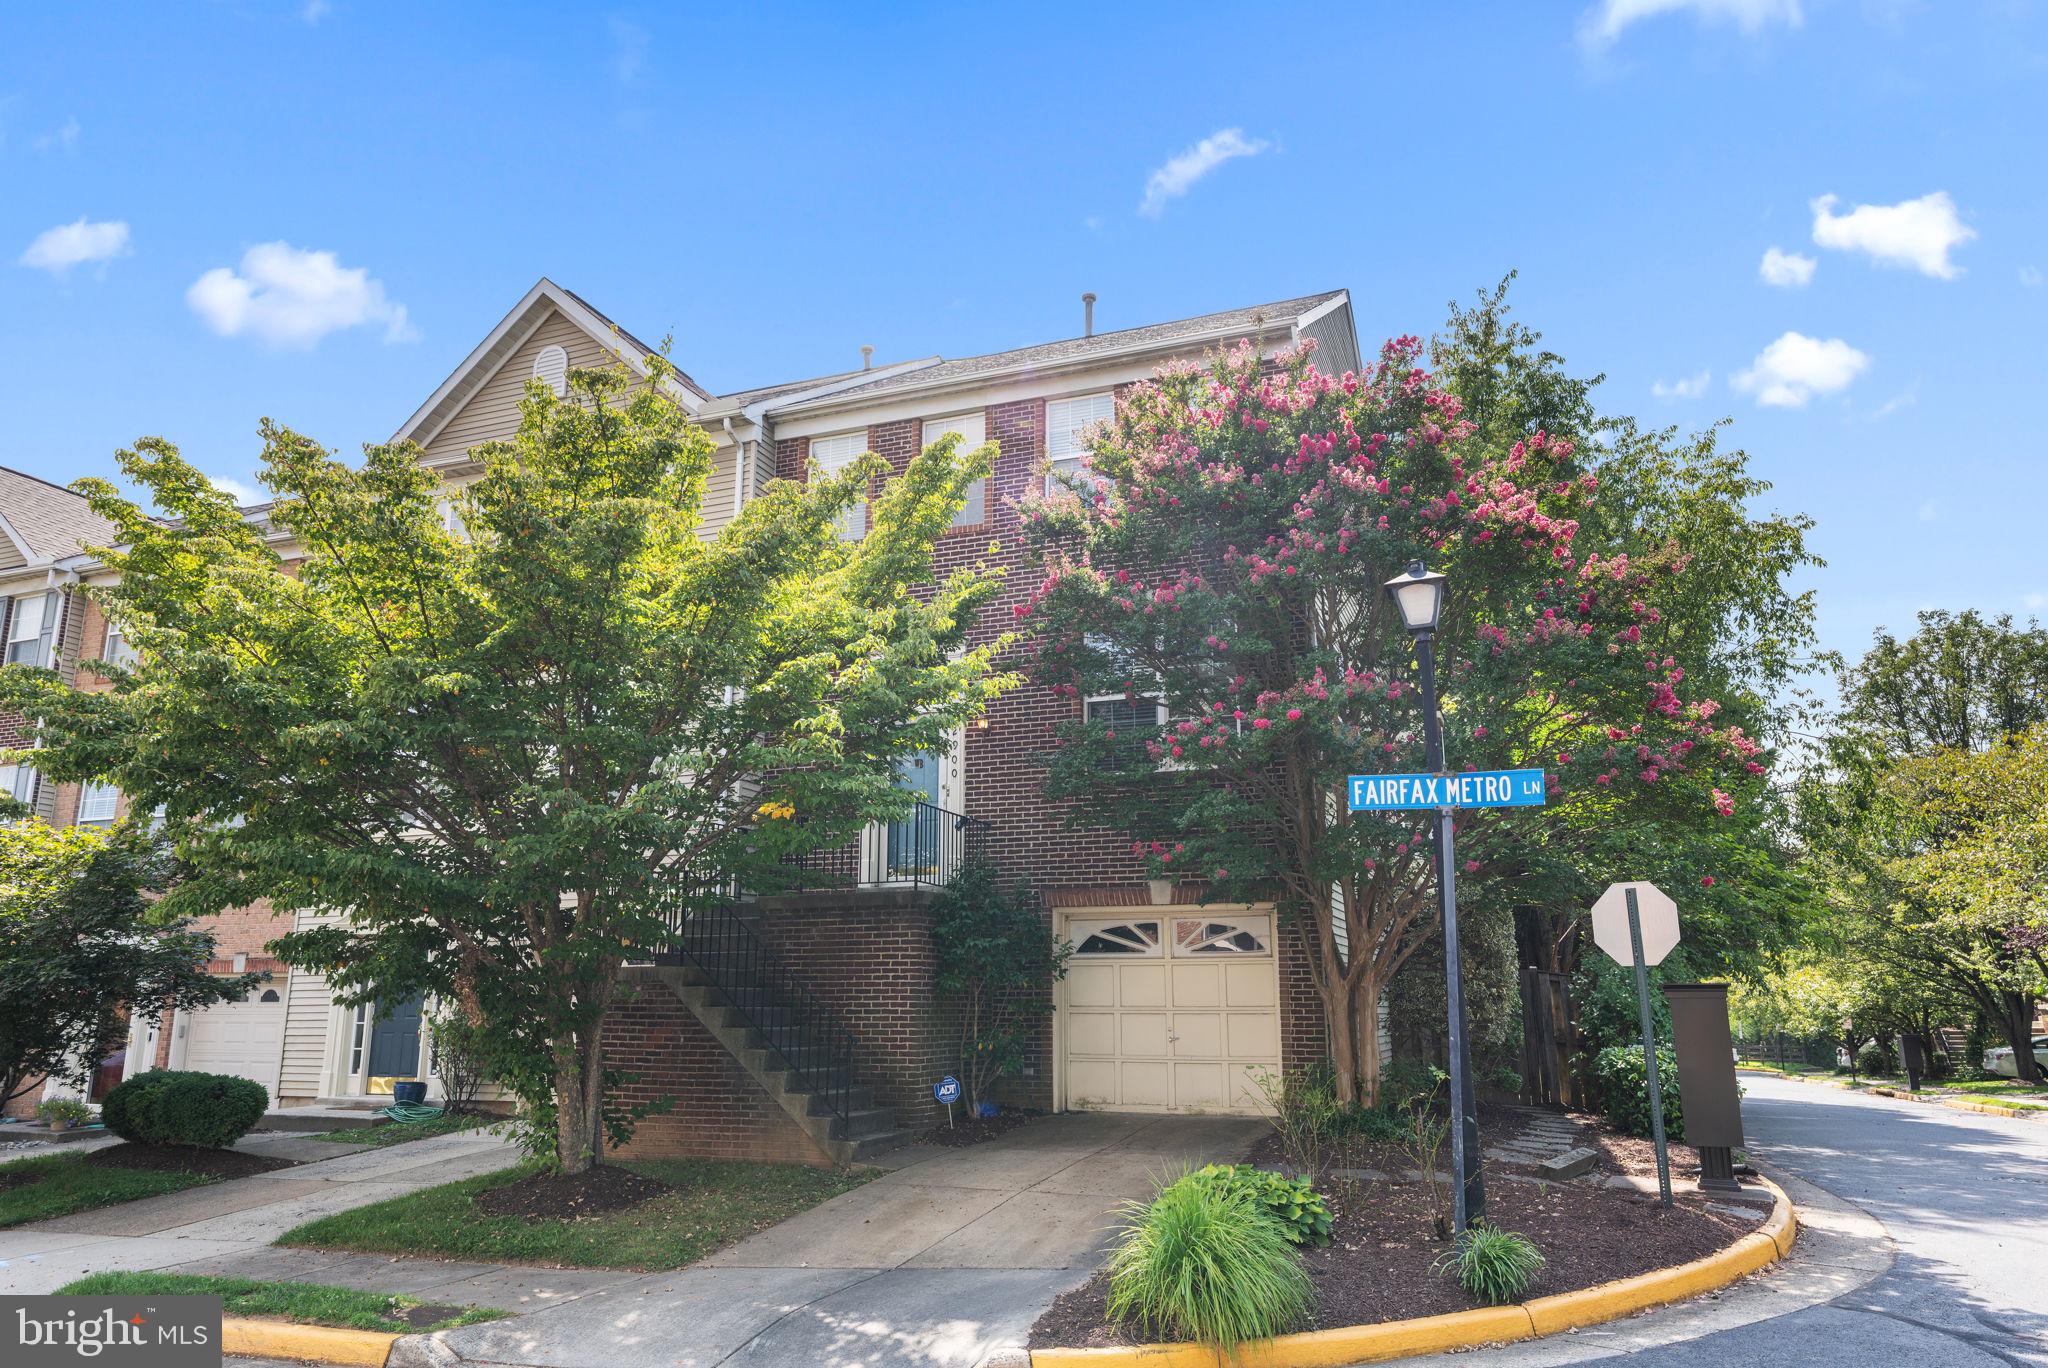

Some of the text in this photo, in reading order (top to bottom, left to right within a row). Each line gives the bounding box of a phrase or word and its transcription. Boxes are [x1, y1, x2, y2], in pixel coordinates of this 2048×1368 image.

[1353, 775, 1541, 806] FAIRFAX METRO LN
[939, 1085, 955, 1095] ADT
